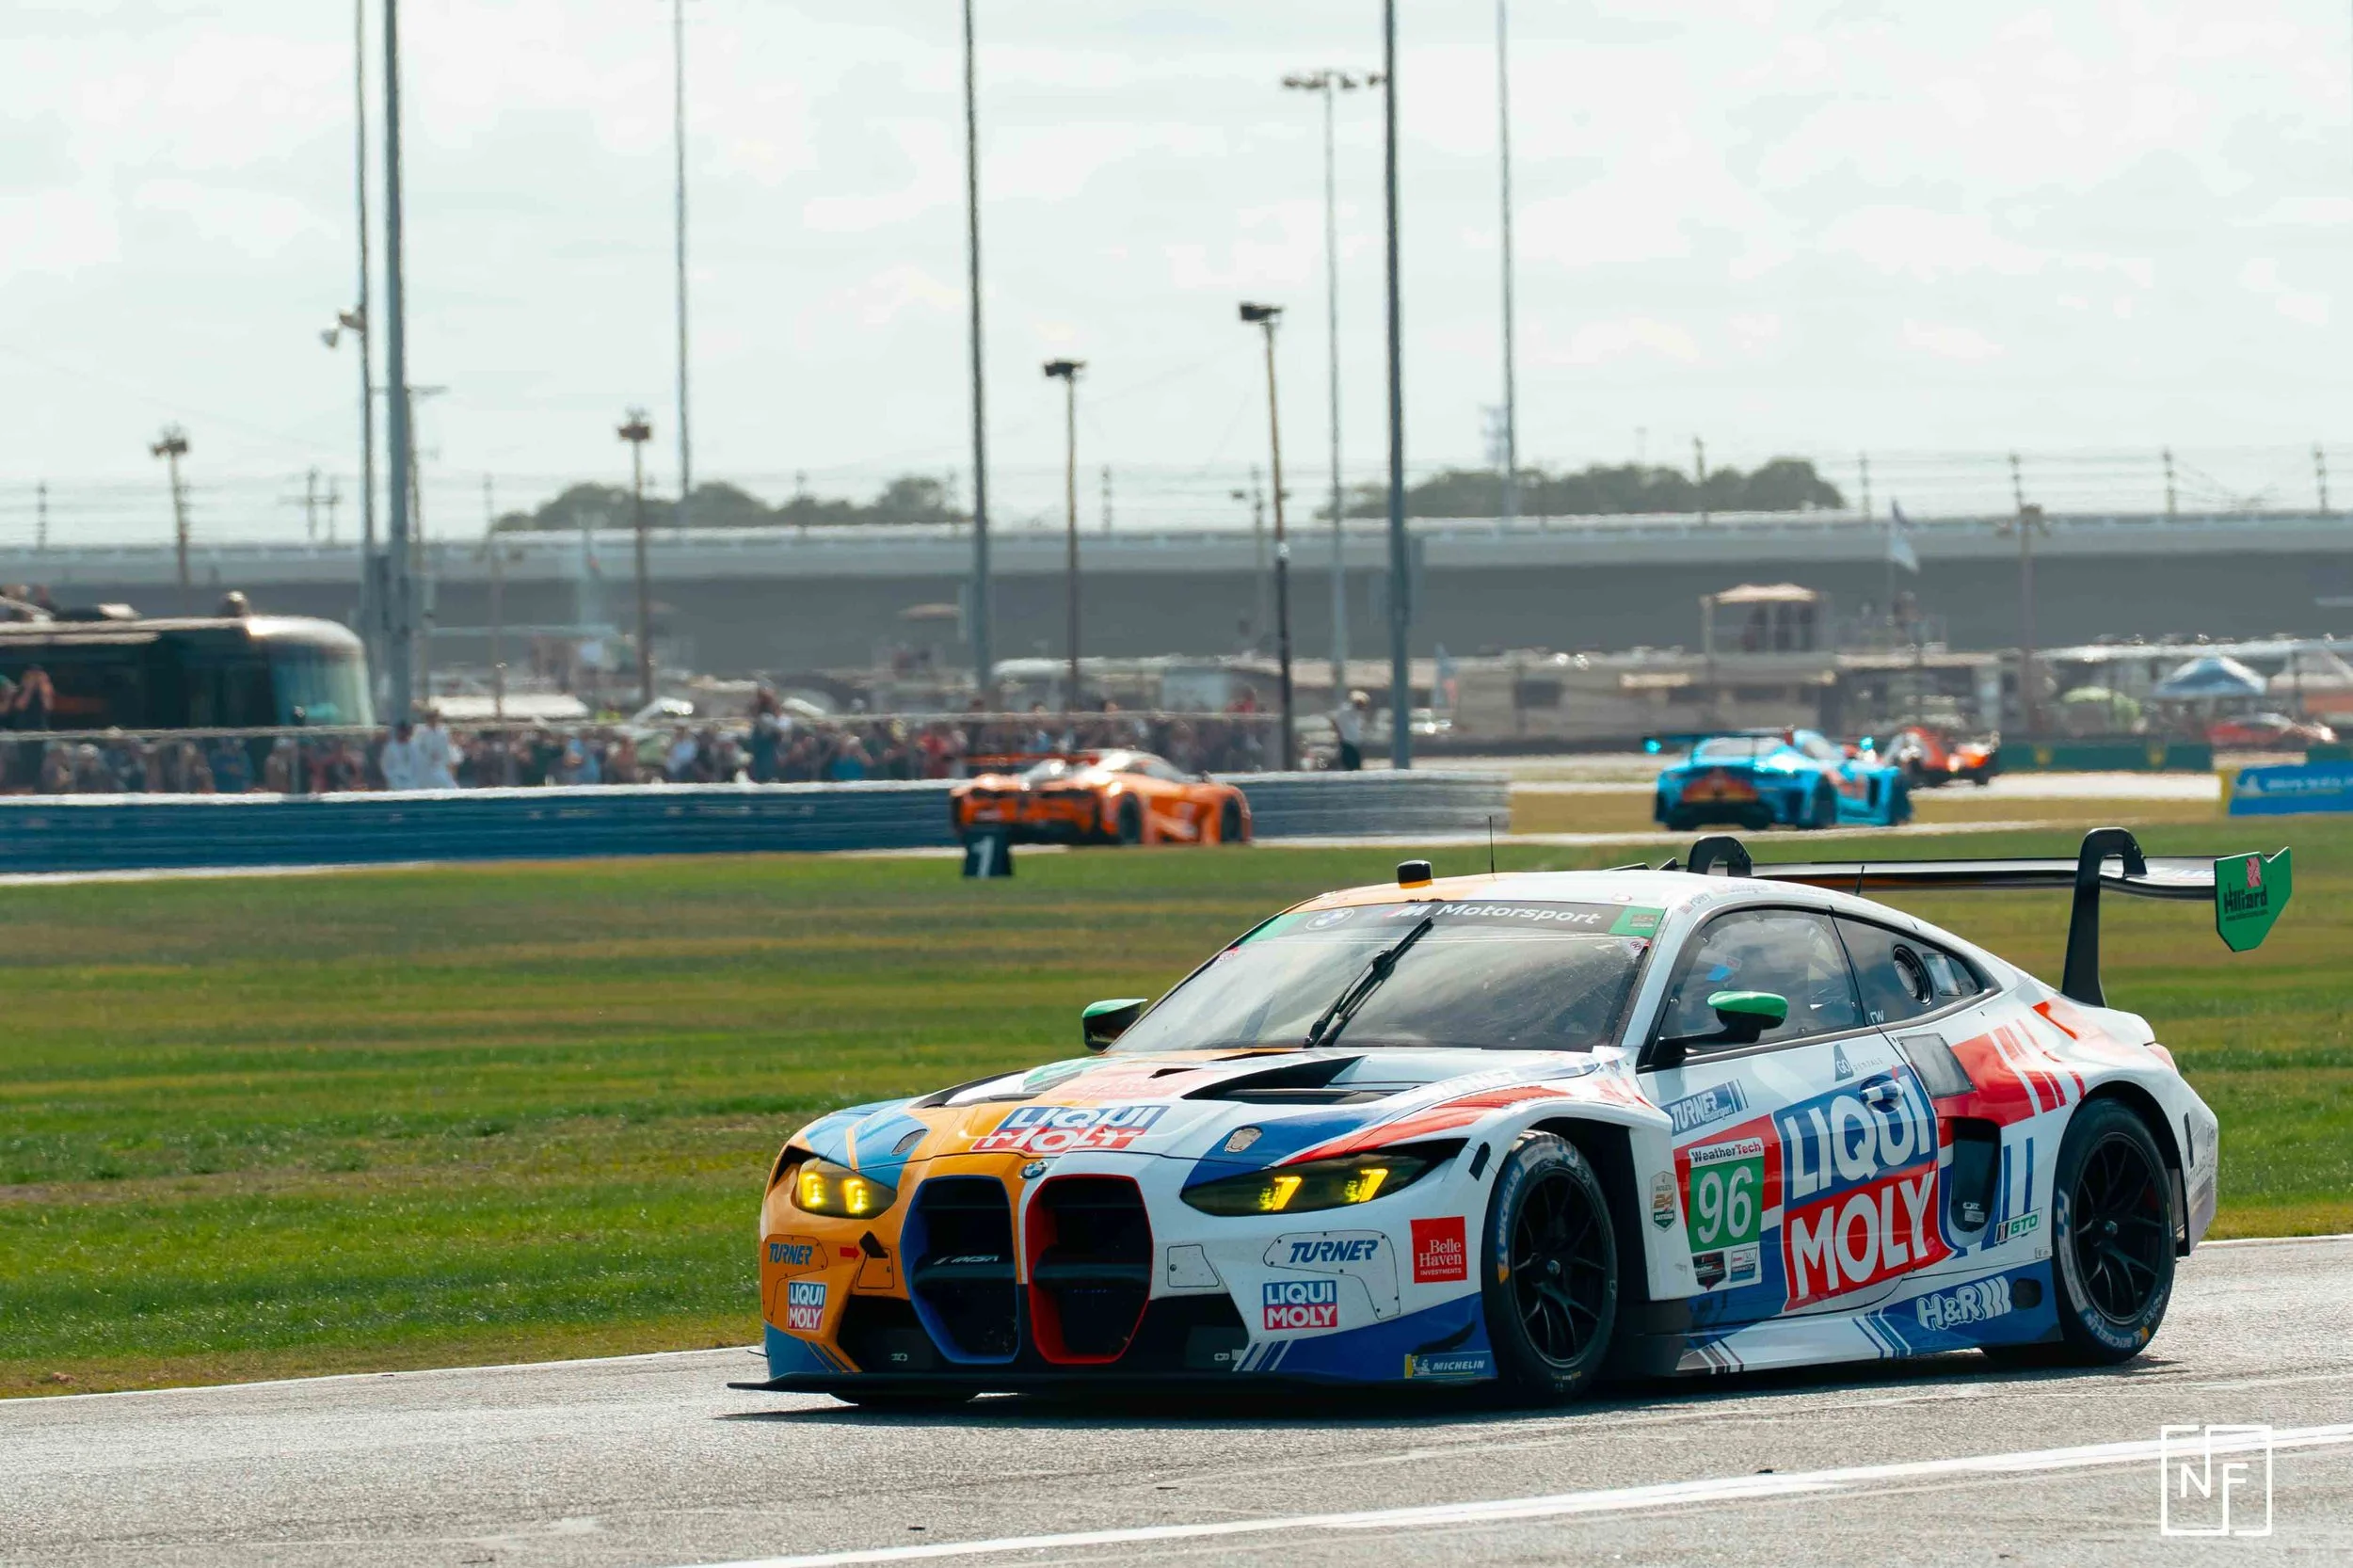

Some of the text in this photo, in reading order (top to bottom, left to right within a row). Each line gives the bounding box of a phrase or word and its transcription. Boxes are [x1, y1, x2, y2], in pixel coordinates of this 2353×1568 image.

[1435, 904, 1603, 925] Motorsport
[1836, 1059, 1851, 1074] GO
[1005, 1106, 1160, 1128] LIQUI
[1670, 1091, 1718, 1131] TURNER
[975, 1127, 1144, 1152] MOLY
[1784, 1075, 1930, 1200] LIQUI
[1691, 1142, 1761, 1163] WeatherTech
[1698, 1166, 1753, 1244] 96
[1430, 1238, 1462, 1255] Belle
[1791, 1171, 1936, 1302] MOLY
[768, 1242, 813, 1266] TURNER
[1289, 1240, 1379, 1263] TURNER
[1418, 1253, 1463, 1269] Haven
[1419, 1268, 1462, 1276] INVESTMENTS
[789, 1284, 824, 1306] LIQUI
[1266, 1282, 1335, 1305] LIQUI
[789, 1307, 823, 1330] MOLY
[1266, 1305, 1336, 1328] MOLY
[1916, 1286, 1985, 1330] H&R
[1433, 1359, 1485, 1371] MICHELIN
